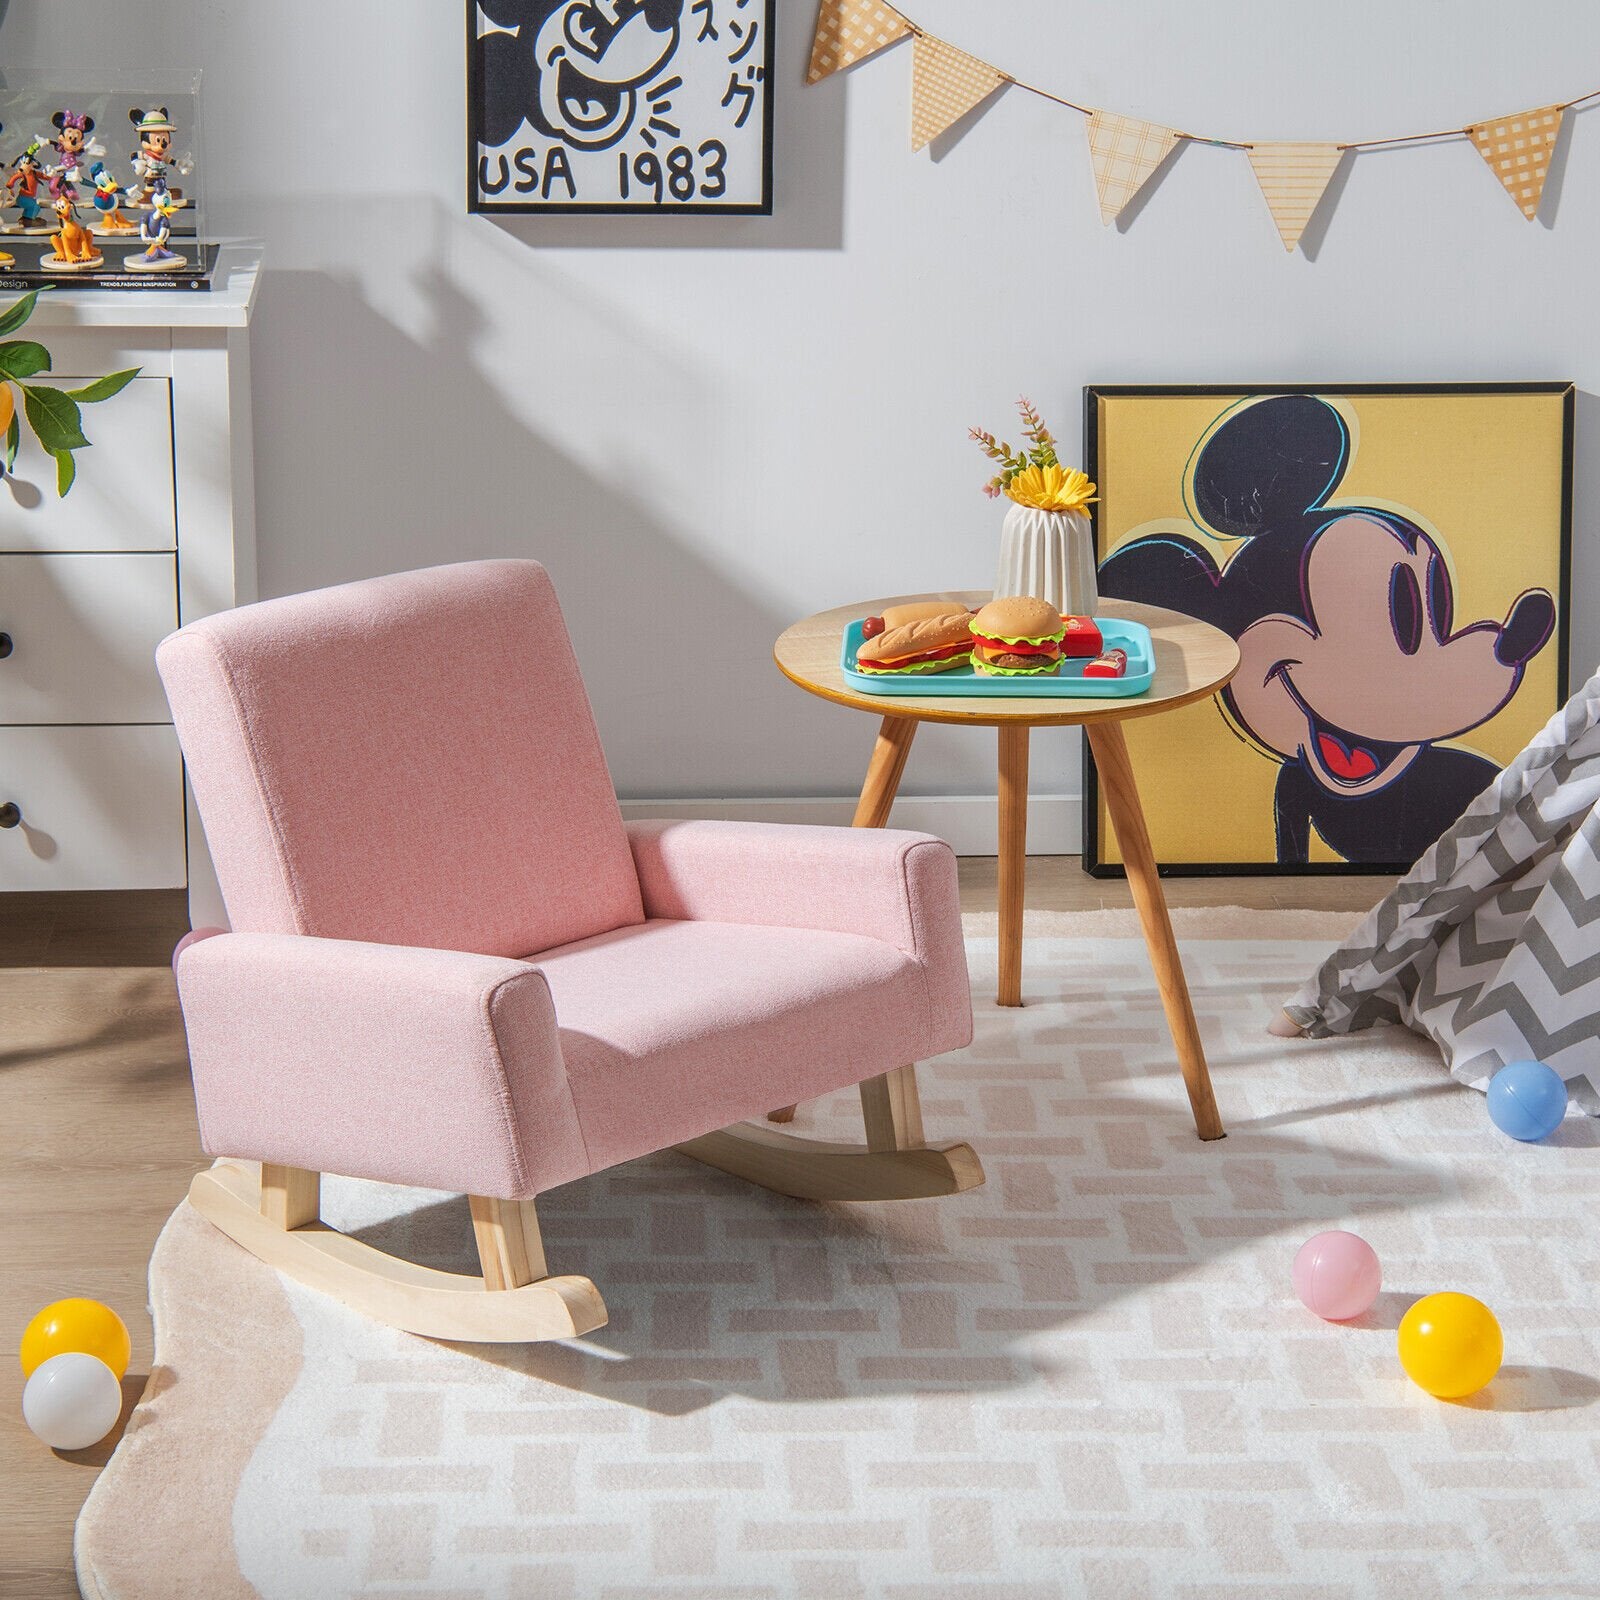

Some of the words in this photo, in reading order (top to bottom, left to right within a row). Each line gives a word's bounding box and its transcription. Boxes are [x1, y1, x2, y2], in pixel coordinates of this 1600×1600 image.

[721, 0, 765, 128] ング
[479, 146, 577, 200] USA
[618, 138, 727, 203] 1983
